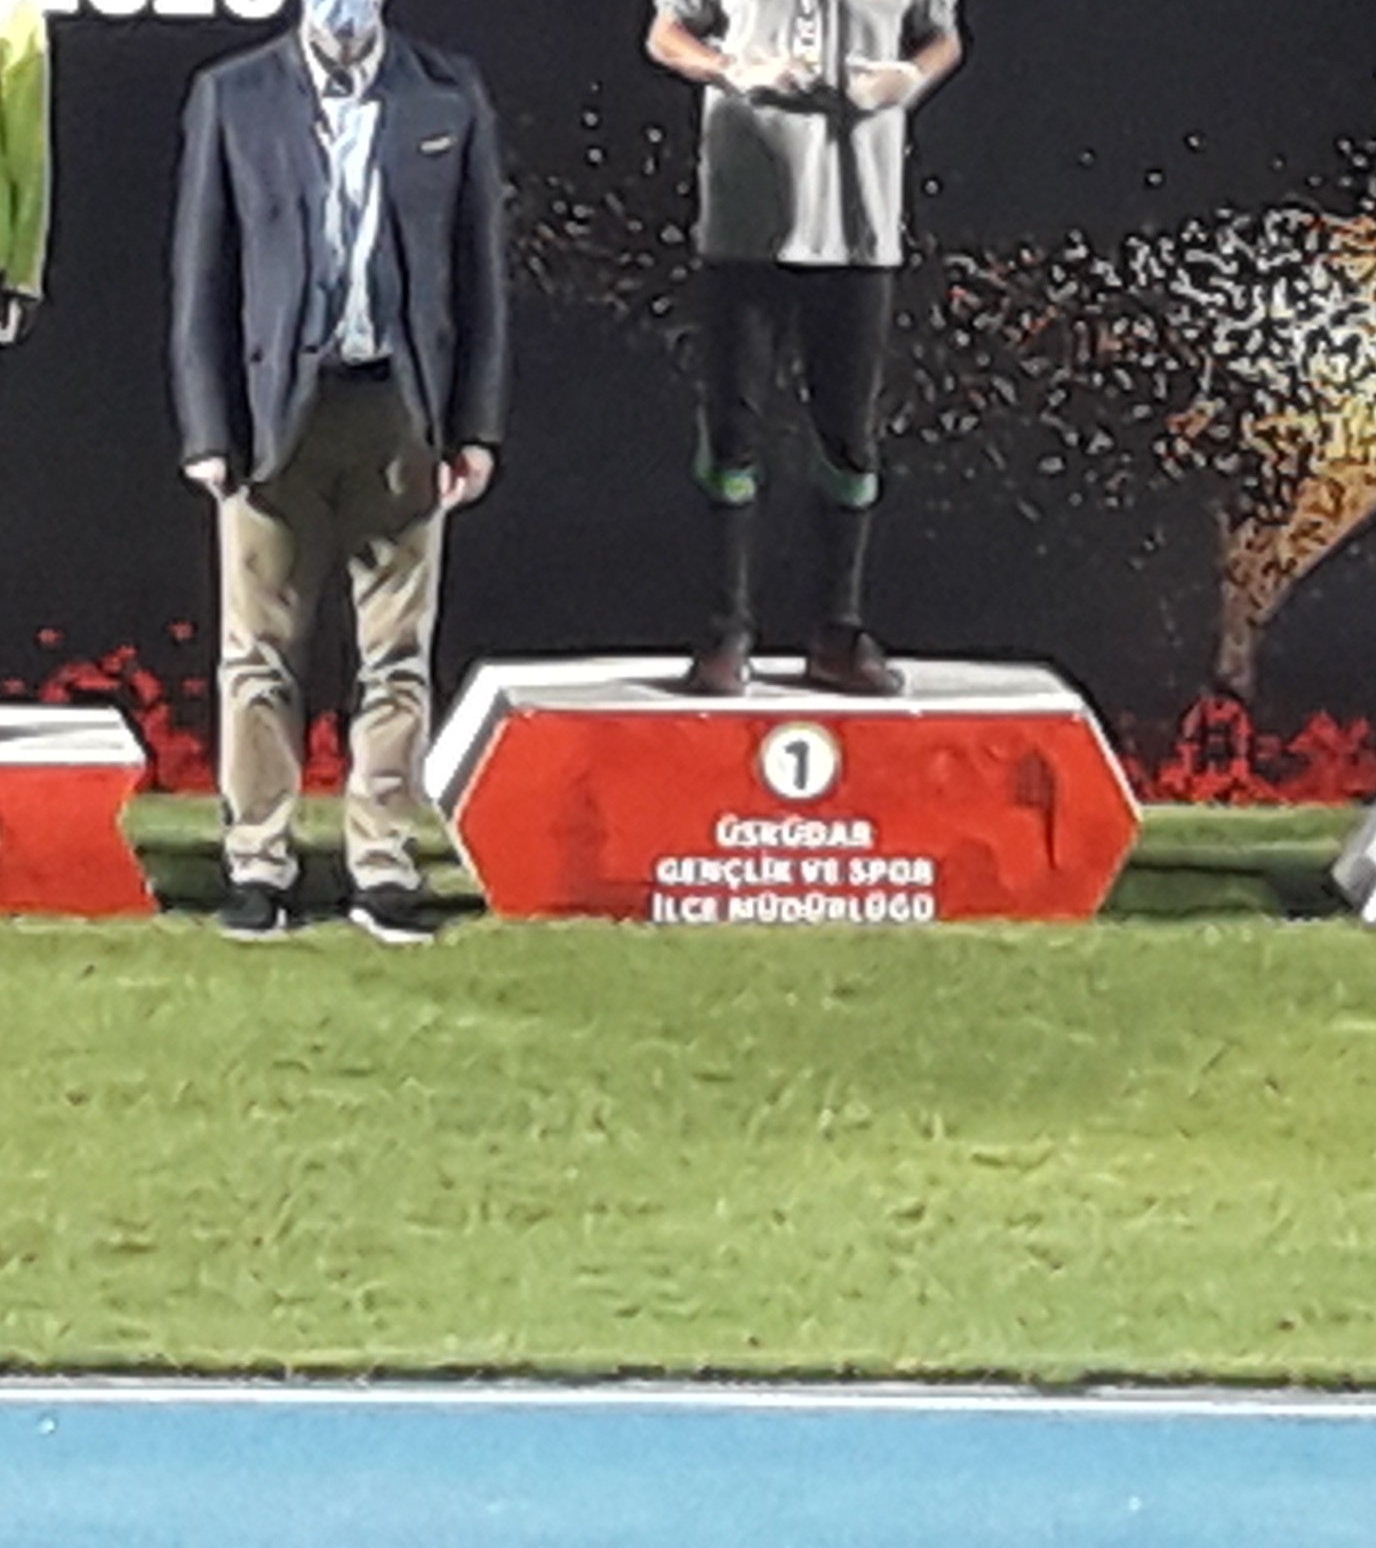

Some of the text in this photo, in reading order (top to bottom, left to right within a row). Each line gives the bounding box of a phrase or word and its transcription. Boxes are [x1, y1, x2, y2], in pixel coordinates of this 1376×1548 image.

[784, 740, 810, 791] 1
[655, 849, 793, 891] GENÇLİK
[848, 855, 934, 887] SPOR
